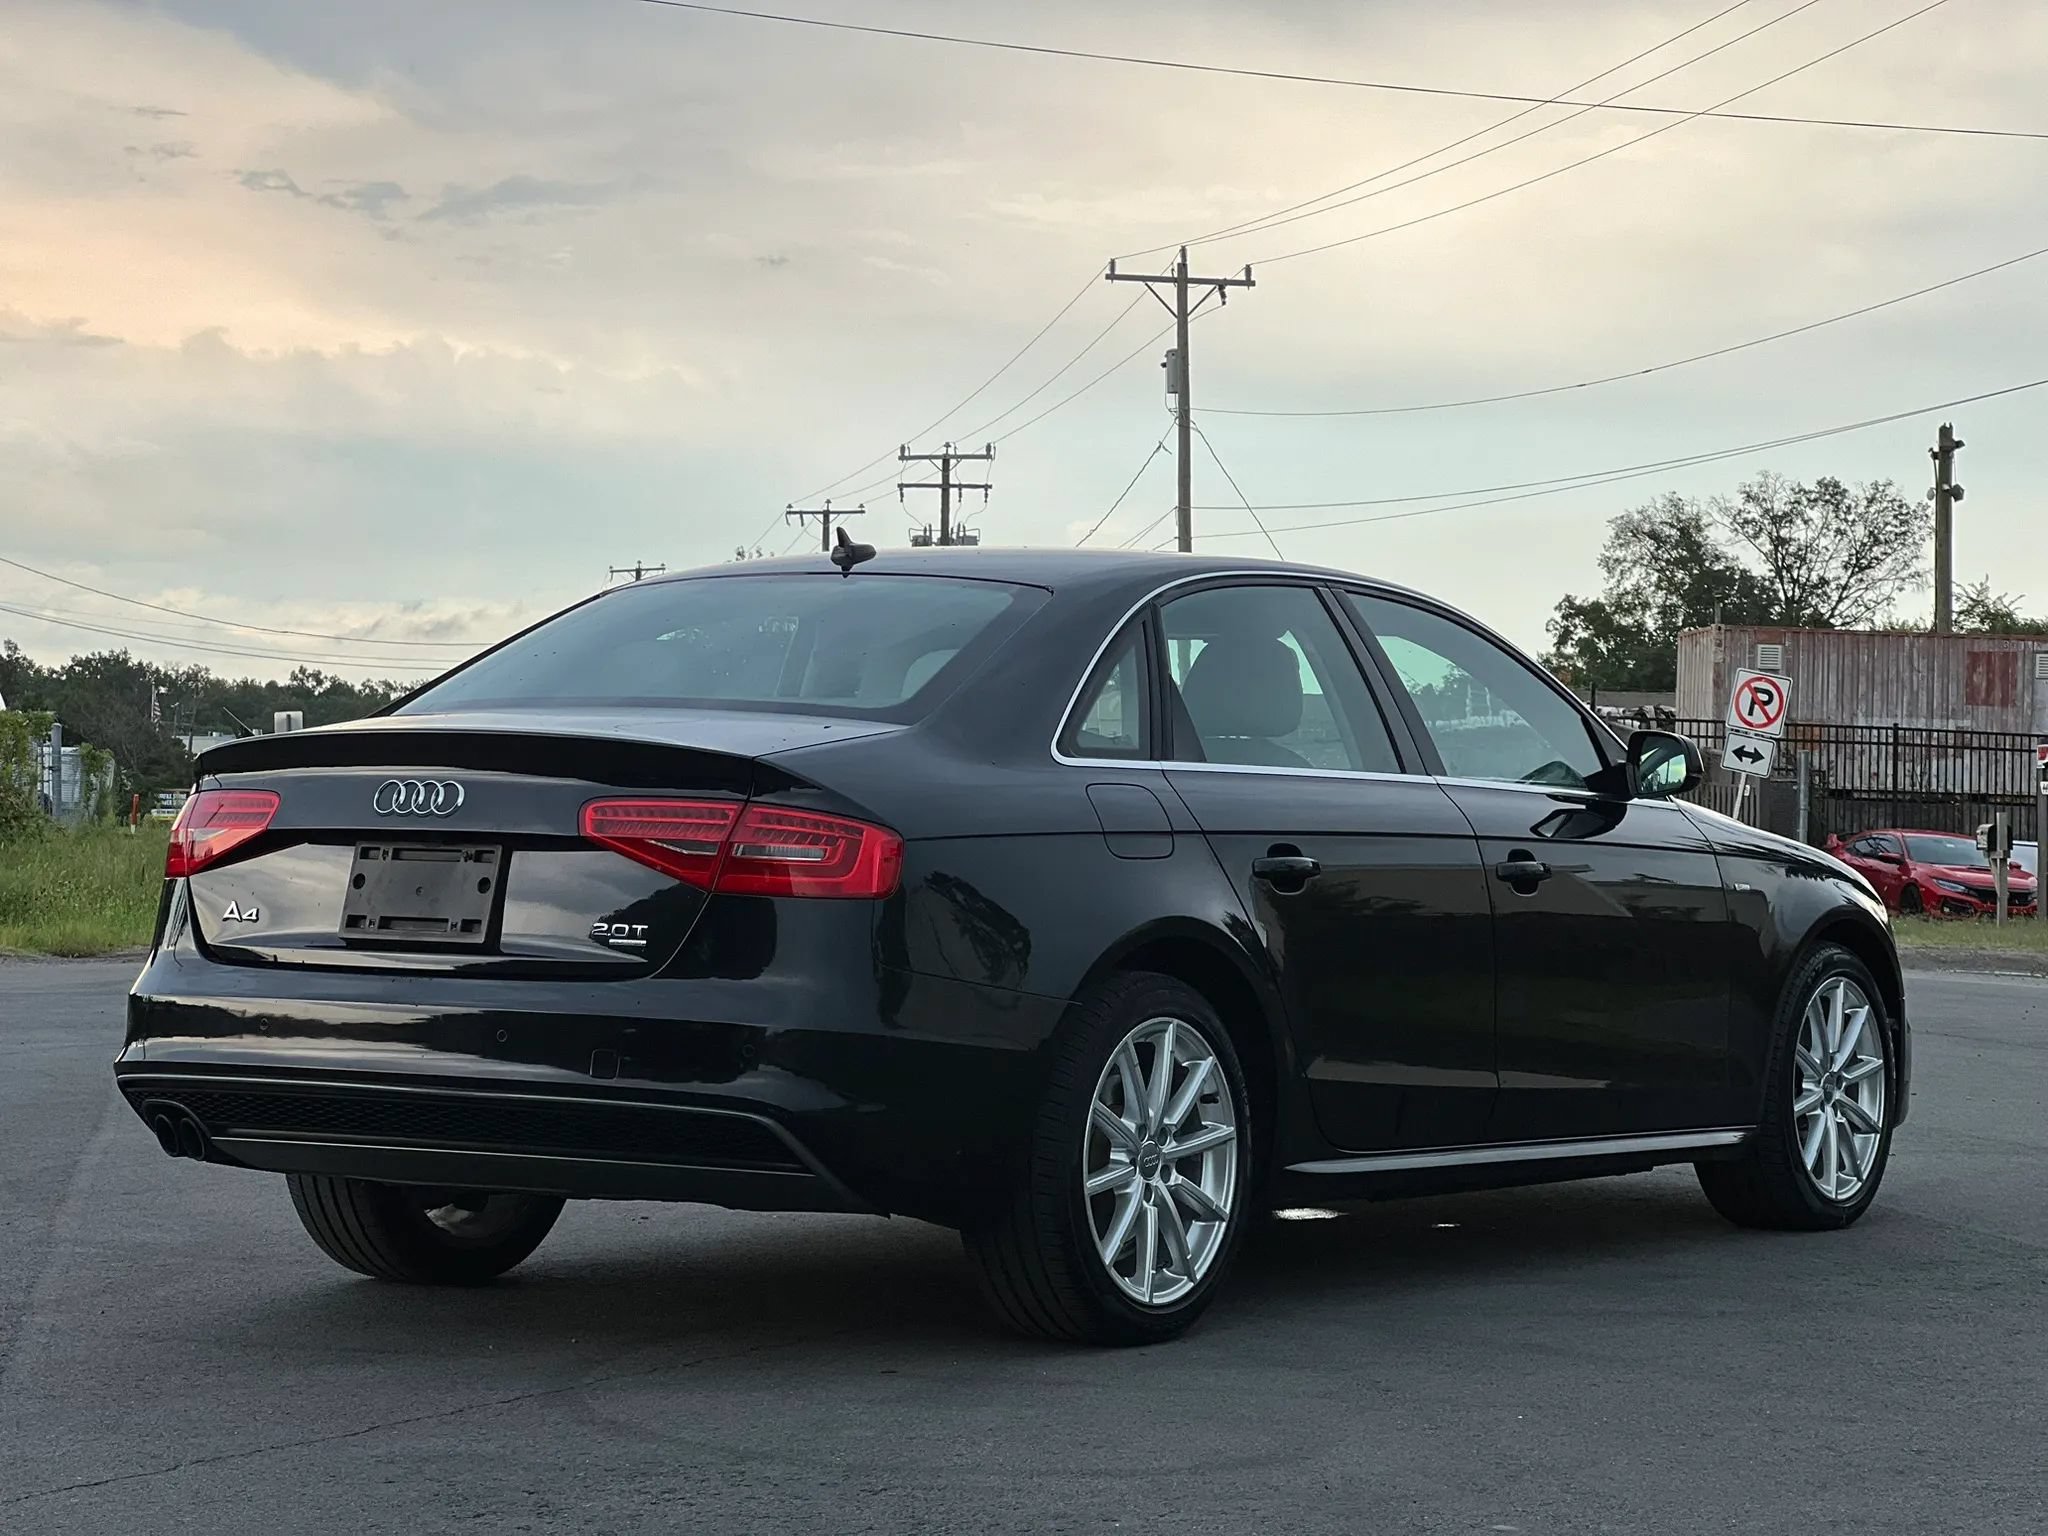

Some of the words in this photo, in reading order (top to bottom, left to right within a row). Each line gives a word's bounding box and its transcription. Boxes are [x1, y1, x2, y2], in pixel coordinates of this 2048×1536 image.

[1747, 686, 1774, 716] P
[222, 899, 259, 923] A4
[591, 922, 649, 937] 2.0T
